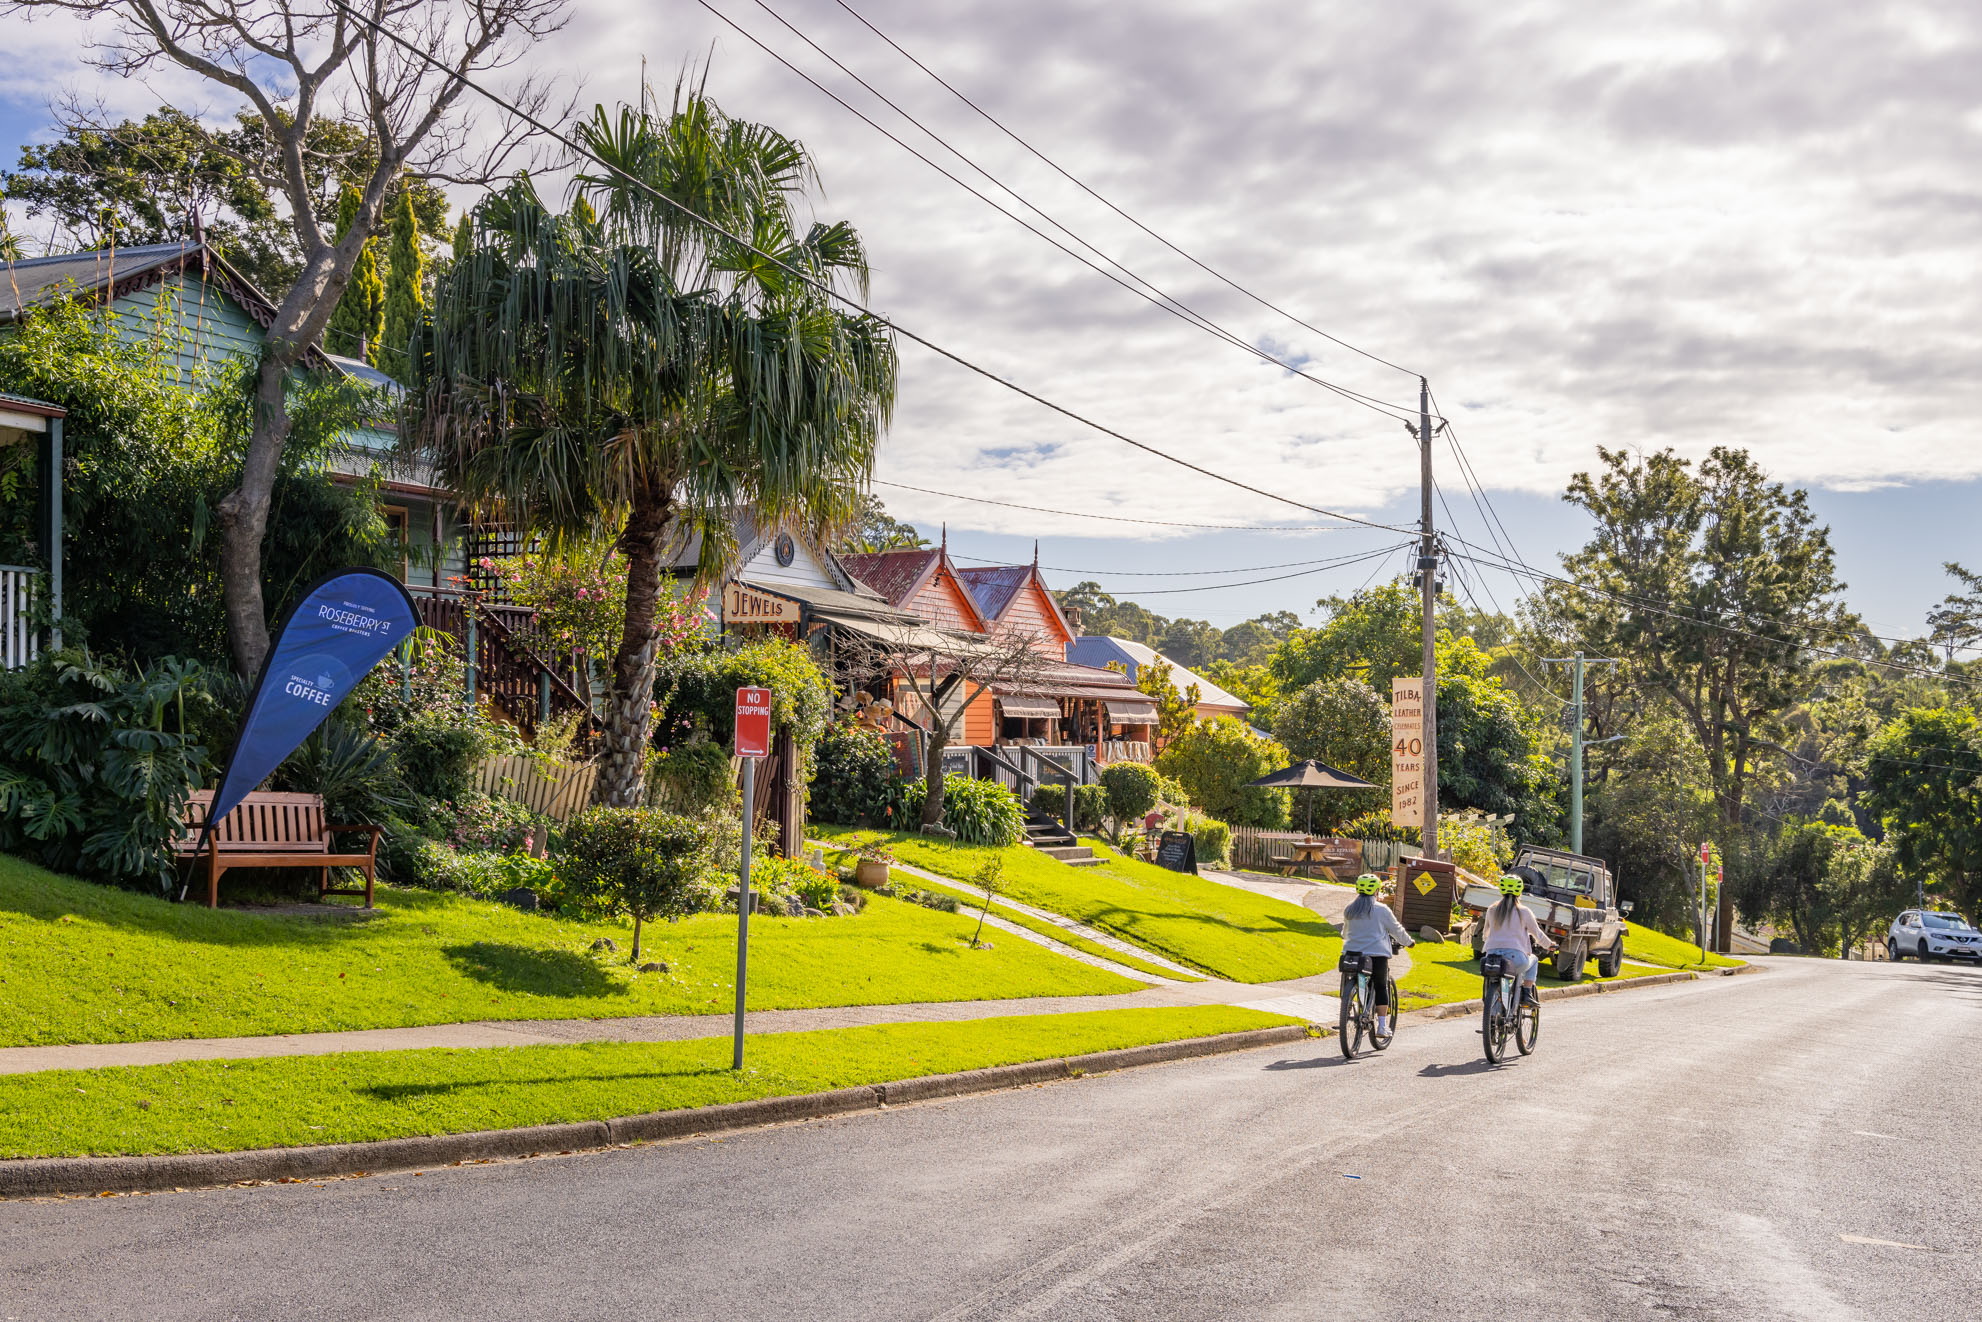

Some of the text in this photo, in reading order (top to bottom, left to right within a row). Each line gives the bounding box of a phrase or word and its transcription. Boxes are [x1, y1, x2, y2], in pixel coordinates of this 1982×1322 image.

[318, 605, 381, 631] ROSEBERRY
[291, 675, 314, 687] SPECIALTY
[285, 681, 331, 706] COFFEE
[746, 692, 761, 704] NO
[1395, 690, 1421, 703] TILBA
[737, 705, 769, 716] STOPPING
[1394, 708, 1421, 717] LEATHER
[1394, 738, 1422, 757] 40
[1396, 763, 1420, 772] YEARS
[1396, 780, 1419, 796] SINCE
[1399, 796, 1417, 810] 1982
